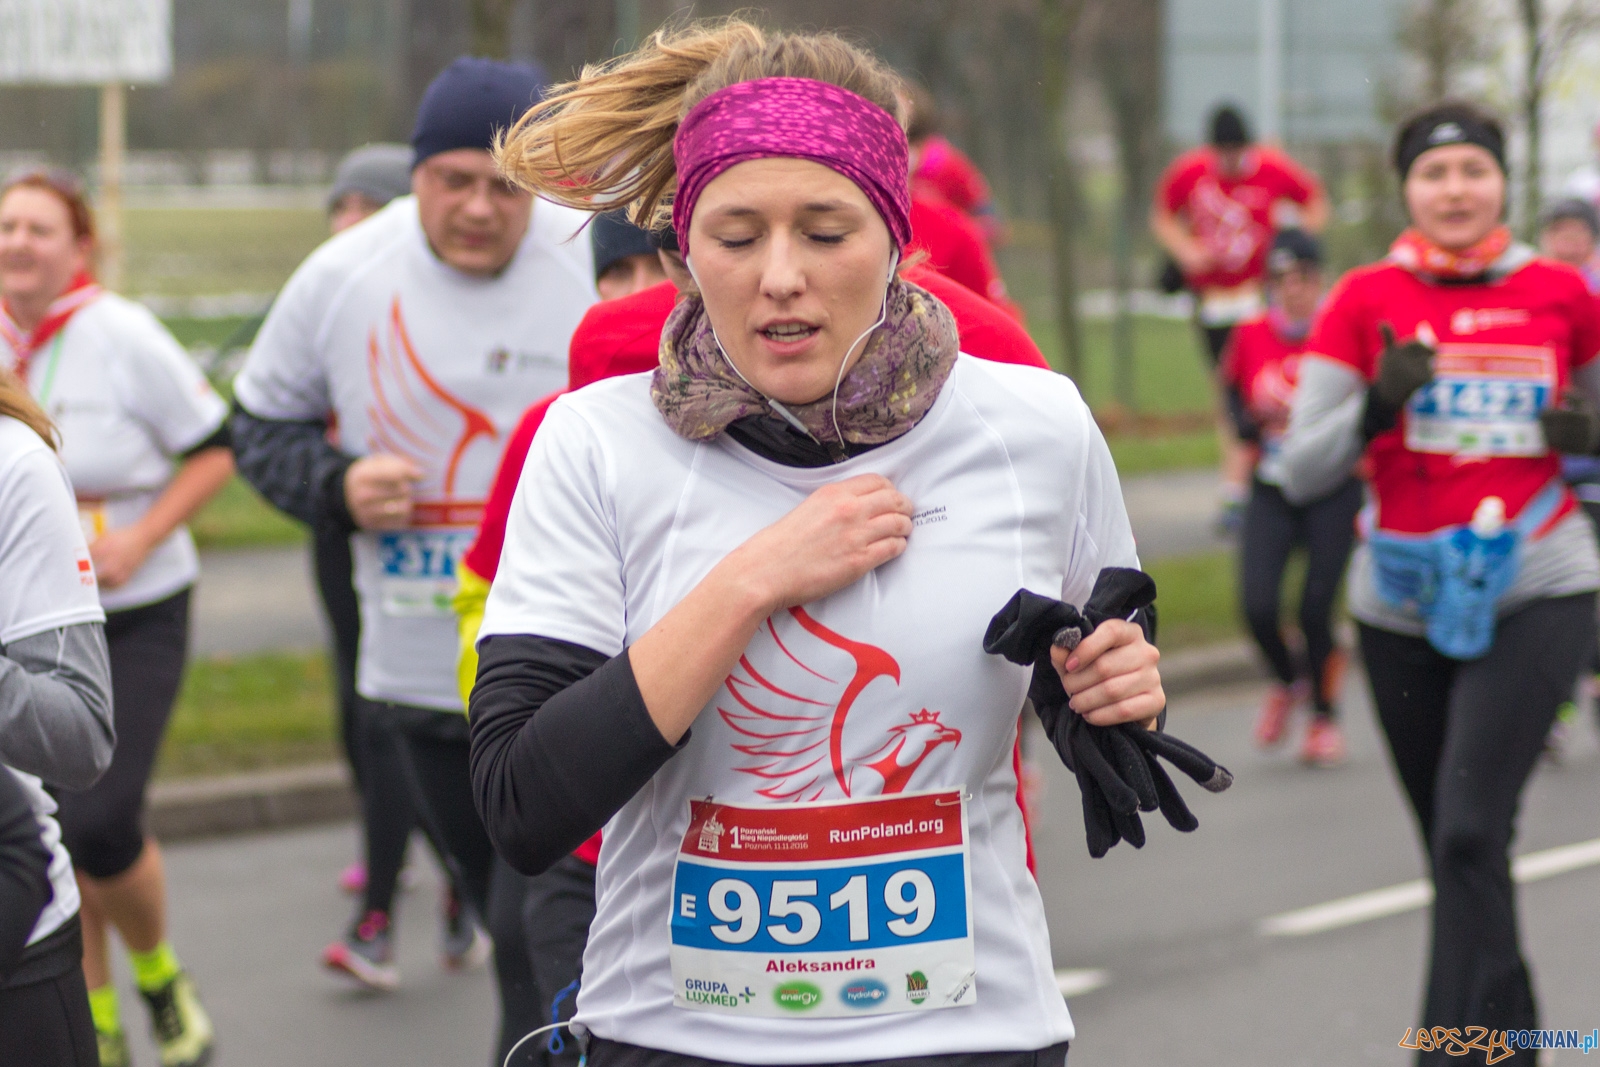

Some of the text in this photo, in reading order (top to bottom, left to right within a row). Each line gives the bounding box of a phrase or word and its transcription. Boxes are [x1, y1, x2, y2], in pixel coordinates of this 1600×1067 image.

[729, 825, 777, 849] 1 Poznański
[740, 833, 809, 842] Bieg Niepodległości
[829, 818, 944, 843] RunPoland.org
[774, 841, 809, 850] 11.11.2016
[680, 868, 937, 946] E 9519
[765, 957, 876, 973] Aleksandra
[685, 978, 730, 995] GRUPA
[686, 991, 739, 1008] LUXMED
[780, 991, 818, 1005] energy
